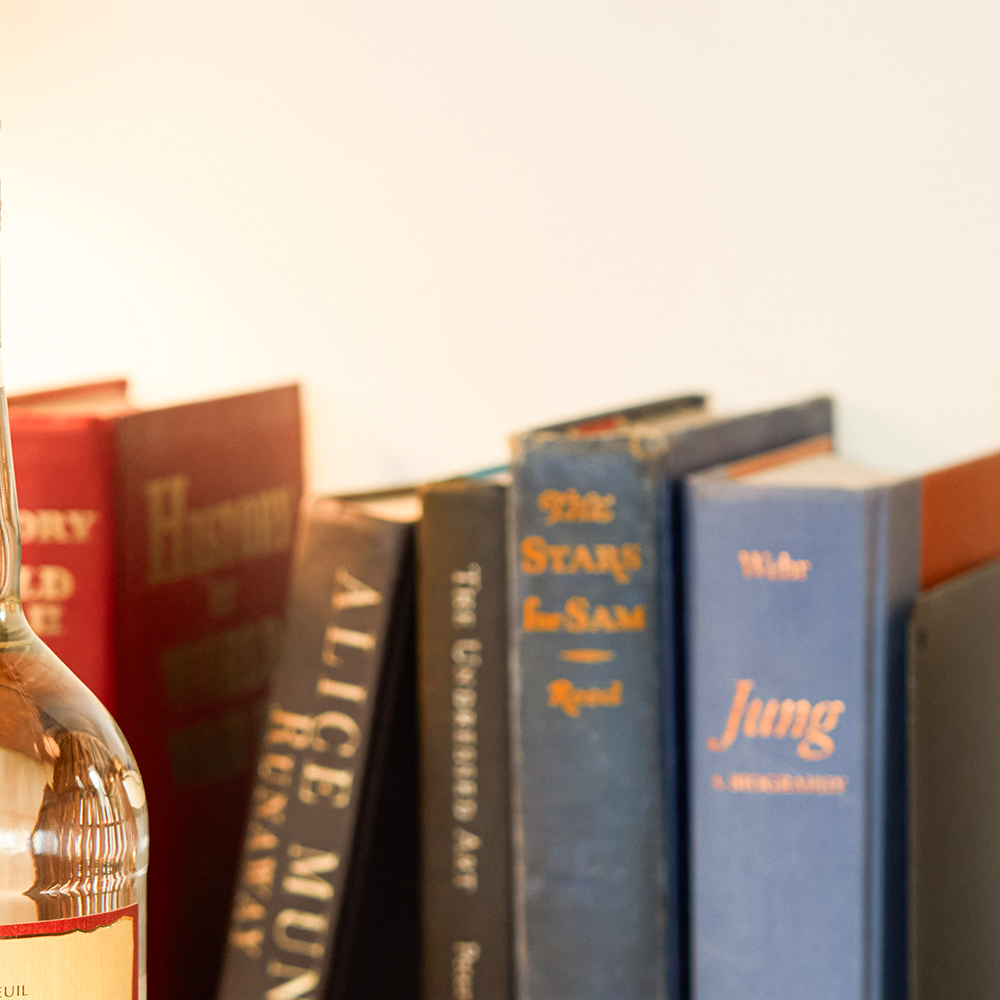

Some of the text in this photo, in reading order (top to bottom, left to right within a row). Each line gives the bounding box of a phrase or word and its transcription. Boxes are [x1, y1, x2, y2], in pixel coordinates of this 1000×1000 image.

[520, 535, 643, 585] STARS
[561, 595, 646, 633] SAM
[298, 566, 383, 809] ALICE
[706, 679, 846, 761] Jung
